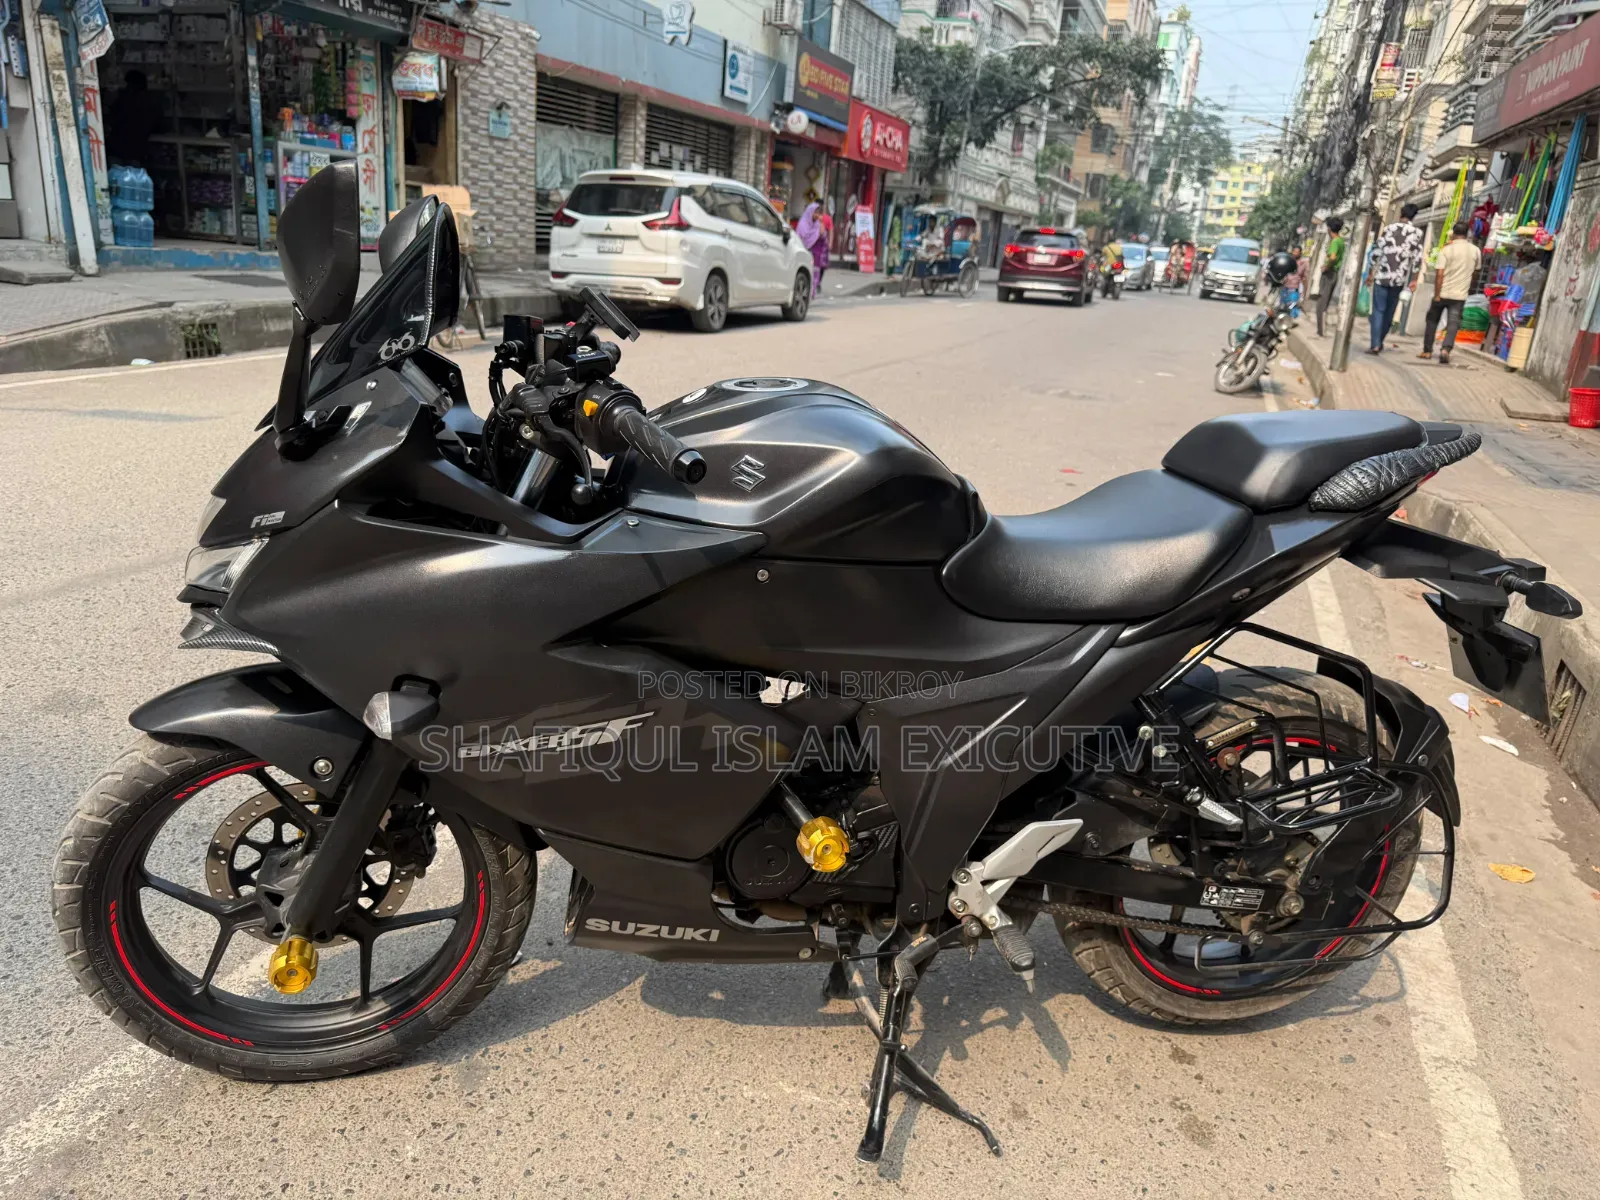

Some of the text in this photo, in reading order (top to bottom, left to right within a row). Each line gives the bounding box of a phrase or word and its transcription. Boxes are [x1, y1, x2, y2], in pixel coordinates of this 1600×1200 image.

[1525, 54, 1561, 96] NIPPON
[1557, 37, 1591, 77] PAINT
[584, 918, 720, 942] SUZUKI
